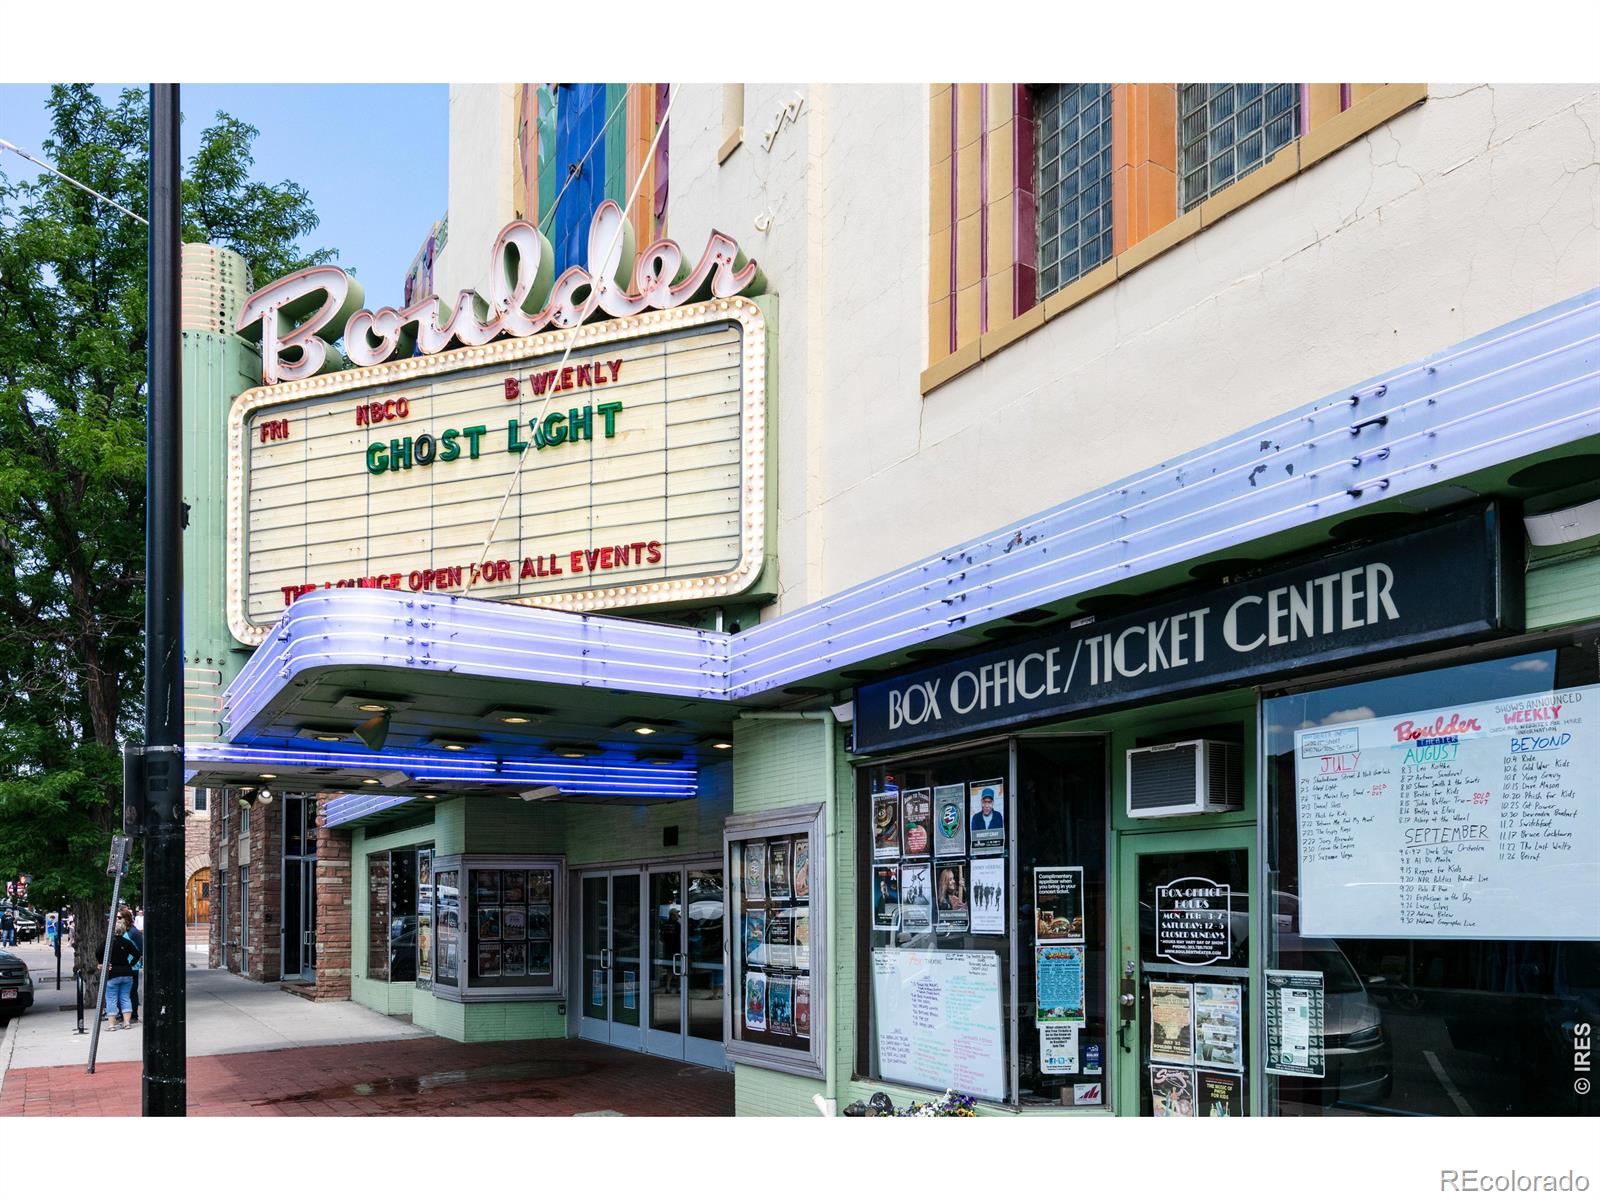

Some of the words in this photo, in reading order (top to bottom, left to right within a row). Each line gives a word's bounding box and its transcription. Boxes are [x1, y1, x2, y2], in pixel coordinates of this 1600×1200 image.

[236, 199, 762, 386] Boulder
[505, 378, 519, 399] B
[530, 359, 623, 395] WEEKLY
[260, 418, 289, 443] FRI
[366, 424, 486, 475] GHOST
[508, 401, 622, 453] LIGHT
[409, 566, 462, 591] OPEN
[521, 554, 562, 579] ALL
[570, 540, 661, 573] EVENTS
[888, 679, 941, 731] BOX
[1222, 562, 1400, 653] CENTER
[1495, 702, 1524, 713] SHOWS
[1526, 693, 1582, 708] ANNOUNCED
[1504, 705, 1562, 724] WEEKLY
[1394, 713, 1481, 742] Boulder
[1511, 733, 1571, 752] BEYOND
[1321, 752, 1361, 772] JULY
[1404, 743, 1459, 764] AUGUST
[1555, 759, 1570, 767] Kids
[1561, 790, 1576, 798] Kids
[1405, 825, 1488, 844] SEPTEMBER
